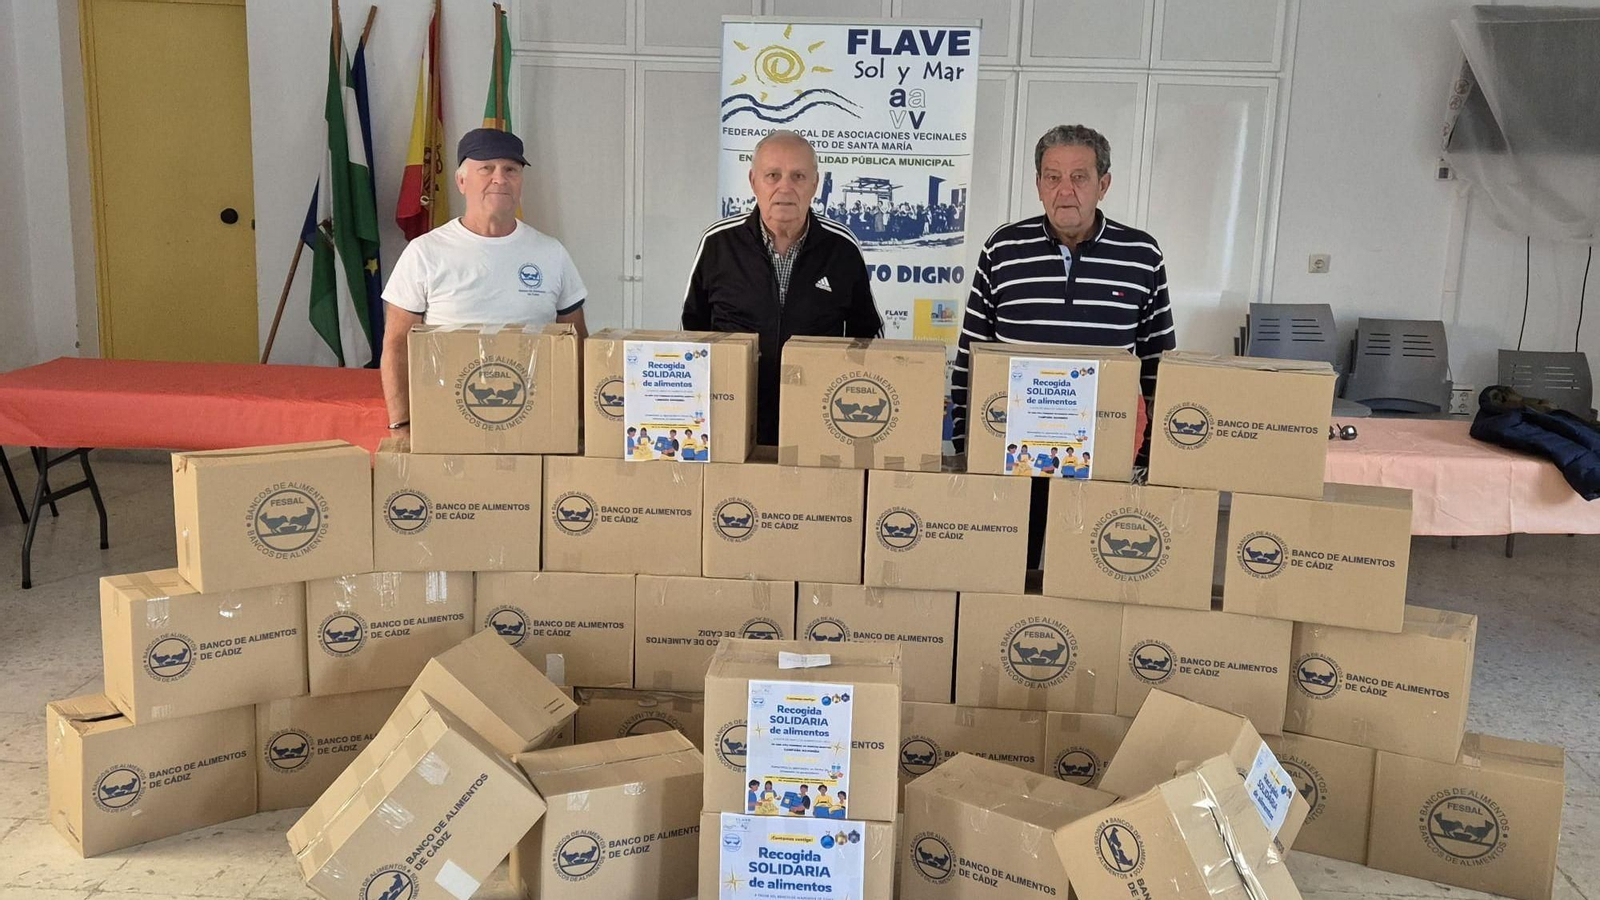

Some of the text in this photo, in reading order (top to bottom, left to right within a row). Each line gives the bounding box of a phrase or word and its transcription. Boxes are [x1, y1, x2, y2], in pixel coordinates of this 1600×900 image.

[847, 29, 971, 56] FLAVE
[854, 58, 964, 84] Sol y Mar
[794, 129, 819, 138] OCAL
[821, 130, 835, 139] DE
[837, 131, 910, 140] ASOCIACIONES
[913, 132, 967, 141] VECINALES
[831, 141, 844, 149] DE
[848, 141, 879, 150] SANTA
[882, 141, 913, 151] MARÍA
[818, 155, 955, 167] LIDAD PÚBLICA MUNICIPAL
[897, 265, 965, 284] DIGNO
[648, 361, 685, 370] Recogida
[642, 370, 691, 378] SOLIDARIA
[654, 380, 692, 388] alimentos
[1033, 378, 1070, 388] Recogida
[846, 386, 877, 394] FESBAL
[1027, 388, 1076, 396] SOLIDARIA
[1038, 397, 1077, 406] alimentos
[1218, 420, 1250, 429] BANCO
[1266, 424, 1318, 434] ALIMENTOS
[1231, 430, 1258, 439] CÁDIZ
[246, 481, 329, 520] BANCOS DE ALIMENTOS
[270, 497, 304, 506] FESBAL
[614, 515, 638, 523] CÁDIZ
[774, 522, 799, 530] CÁDIZ
[971, 525, 1018, 533] ALIMENTOS
[1090, 510, 1118, 538] BANCOS
[1134, 507, 1171, 544] ALIMENTOS
[1115, 522, 1148, 530] FESBAL
[247, 530, 274, 557] BANCOS
[290, 523, 328, 559] ALIMENTOS
[939, 531, 964, 540] CÁDIZ
[1292, 550, 1395, 567] BANCO DE ALIMENTOS
[1306, 561, 1333, 570] CÁDIZ
[371, 620, 401, 629] BANCO
[416, 613, 464, 624] ALIMENTOS
[385, 628, 410, 637] CÁDIZ
[546, 629, 571, 637] CÁDIZ
[1001, 619, 1027, 647] BANCOS
[1041, 617, 1078, 651] ALIMENTOS
[1024, 631, 1055, 639] FESBAL
[200, 639, 232, 650] BANCO
[248, 628, 297, 642] ALIMENTOS
[646, 636, 691, 644] ALIMENTOS
[897, 635, 944, 643] ALIMENTOS
[200, 647, 242, 660] DE CÁDIZ
[1180, 657, 1211, 666] BANCO
[1227, 662, 1278, 674] ALIMENTOS
[1194, 667, 1220, 677] CÁDIZ
[1345, 683, 1387, 697] DE CÁDIZ
[1346, 674, 1450, 699] BANCO DE ALIMENTOS
[777, 705, 822, 715] Recogida
[770, 716, 828, 727] SOLIDARIA
[783, 727, 829, 737] alimentos
[318, 737, 348, 745] BANCO
[852, 741, 885, 750] ENTOS
[988, 754, 1035, 763] ALIMENTOS
[149, 766, 181, 779] BANCO
[197, 750, 247, 768] ALIMENTOS
[164, 773, 191, 786] CÁDIZ
[1420, 789, 1451, 816] BANCOS
[1468, 790, 1510, 831] ALIMENTOS
[1447, 802, 1483, 815] FESBAL
[406, 773, 488, 865] BANCO DE ALIMENTOS
[609, 836, 640, 848] BANCO
[657, 825, 699, 840] ALIMENTO
[414, 830, 452, 872] DE CÁDIZ
[623, 845, 650, 856] CÁDIZ
[758, 847, 821, 862] Recogida
[748, 862, 831, 877] SOLIDARIA
[959, 858, 1056, 896] BANCO DE ALIMENTOS
[959, 869, 998, 887] DE CÁDIZ
[749, 878, 832, 893] de alimentos
